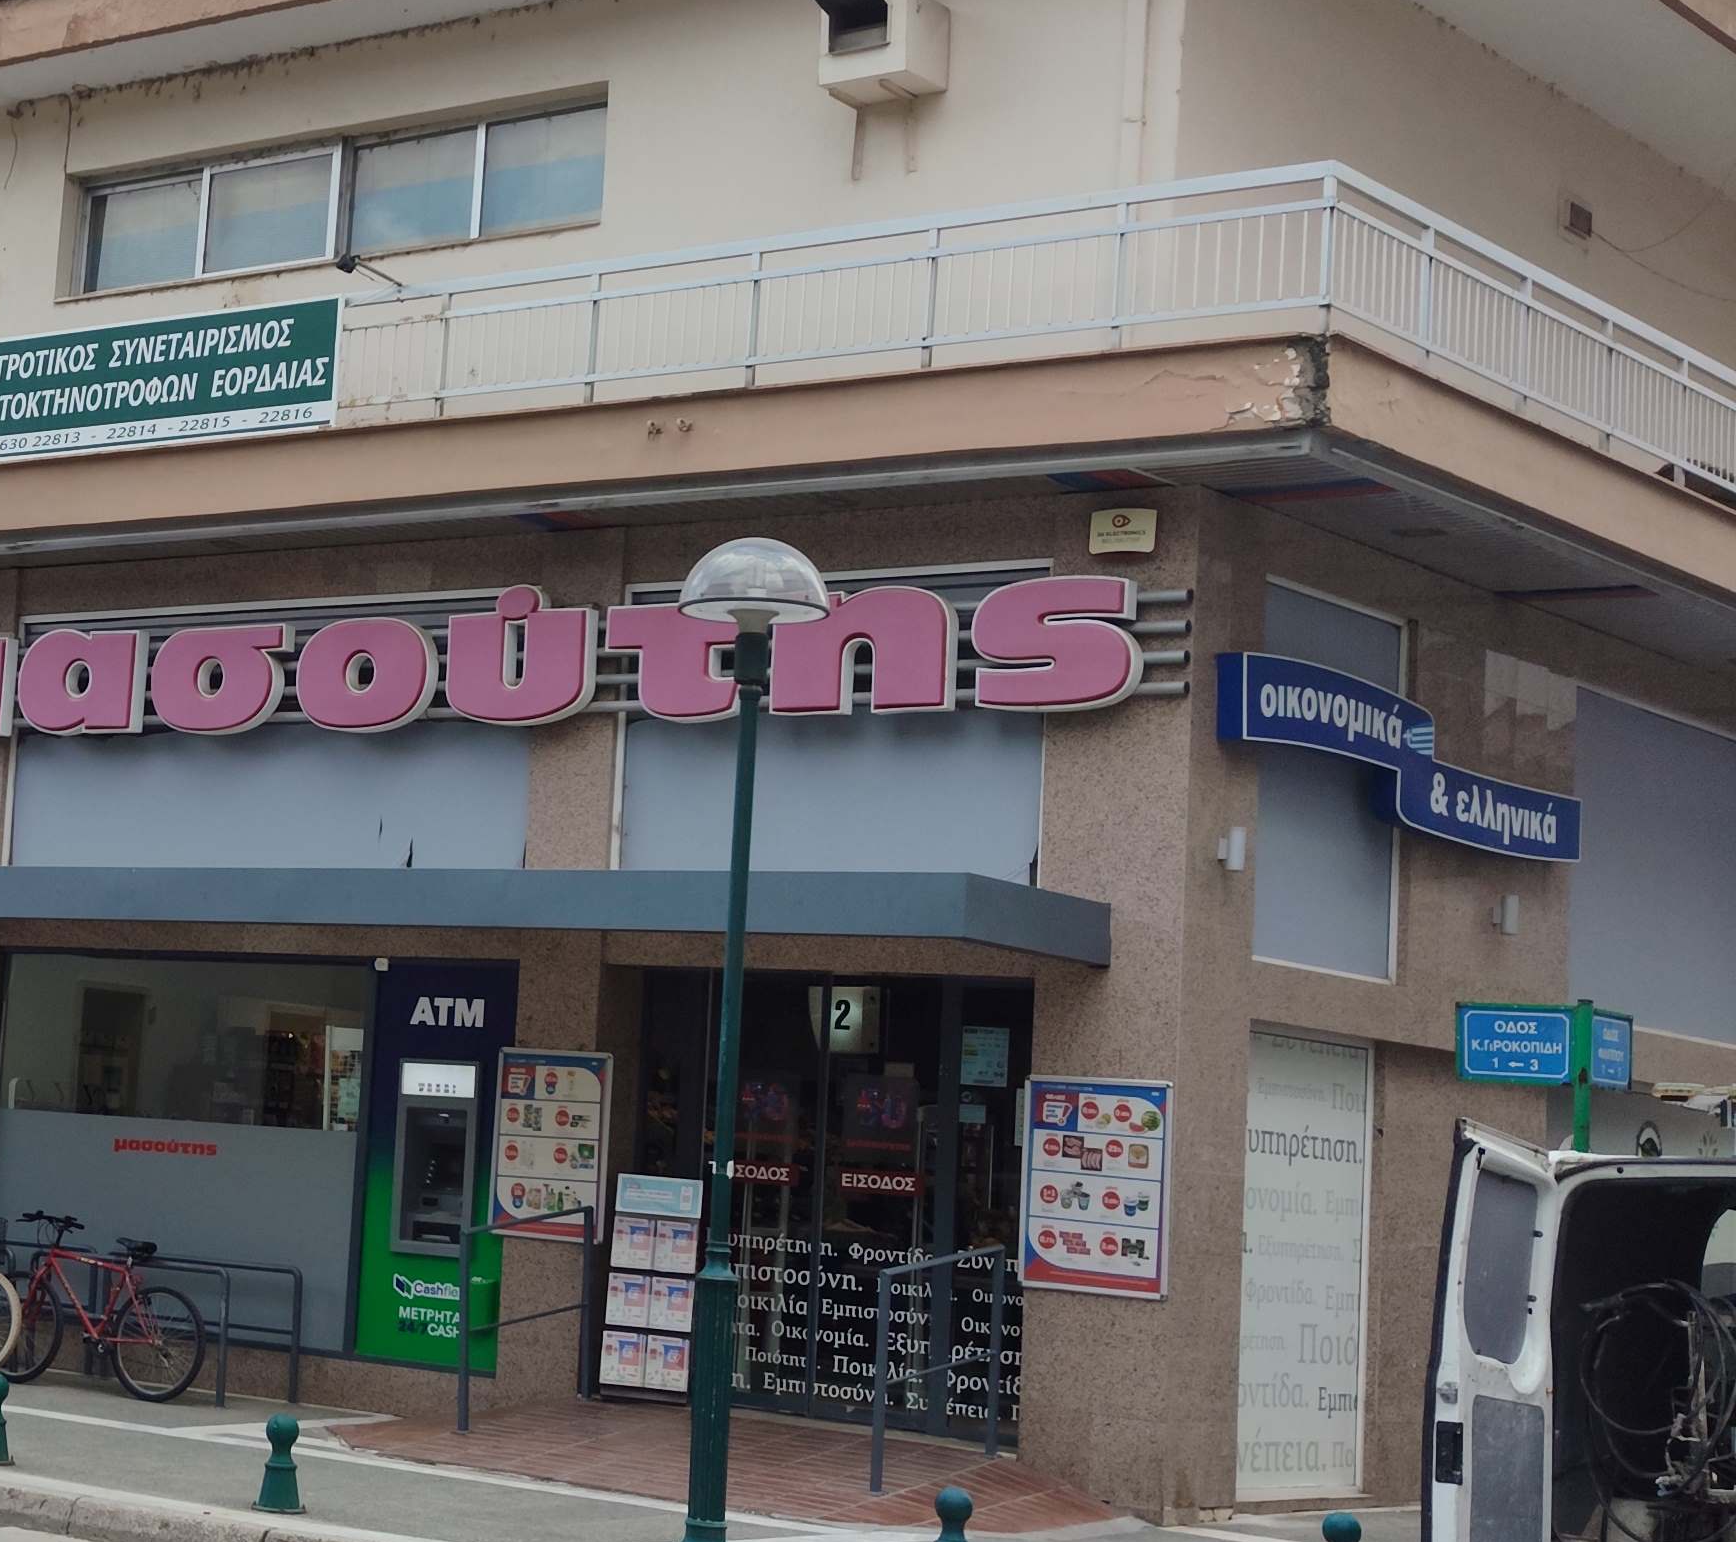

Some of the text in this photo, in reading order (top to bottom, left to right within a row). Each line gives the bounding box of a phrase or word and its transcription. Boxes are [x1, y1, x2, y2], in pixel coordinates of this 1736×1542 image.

[109, 318, 294, 368] ΣΥΝΕΤΑΙΡΙΣΜΟΣ
[211, 357, 330, 398] ΕΟΡΔΑΙΑΣ
[32, 431, 81, 449] 22813
[106, 423, 157, 441] 22814
[179, 415, 231, 433] 22815
[259, 406, 313, 424] 22816
[1260, 682, 1403, 749] οικονομικά
[1430, 772, 1557, 845] & ελληνικά
[410, 996, 485, 1028] ATM
[834, 999, 851, 1031] 2
[1494, 1020, 1538, 1035] ΟΔΟΣ
[1492, 1057, 1539, 1071] 1 3
[735, 1164, 790, 1181] ΣΟΔΟΣ
[841, 1173, 916, 1191] ΕΙΣΟΔΟΣ
[745, 1346, 923, 1384] Ποιότητ. Ποικλία.
